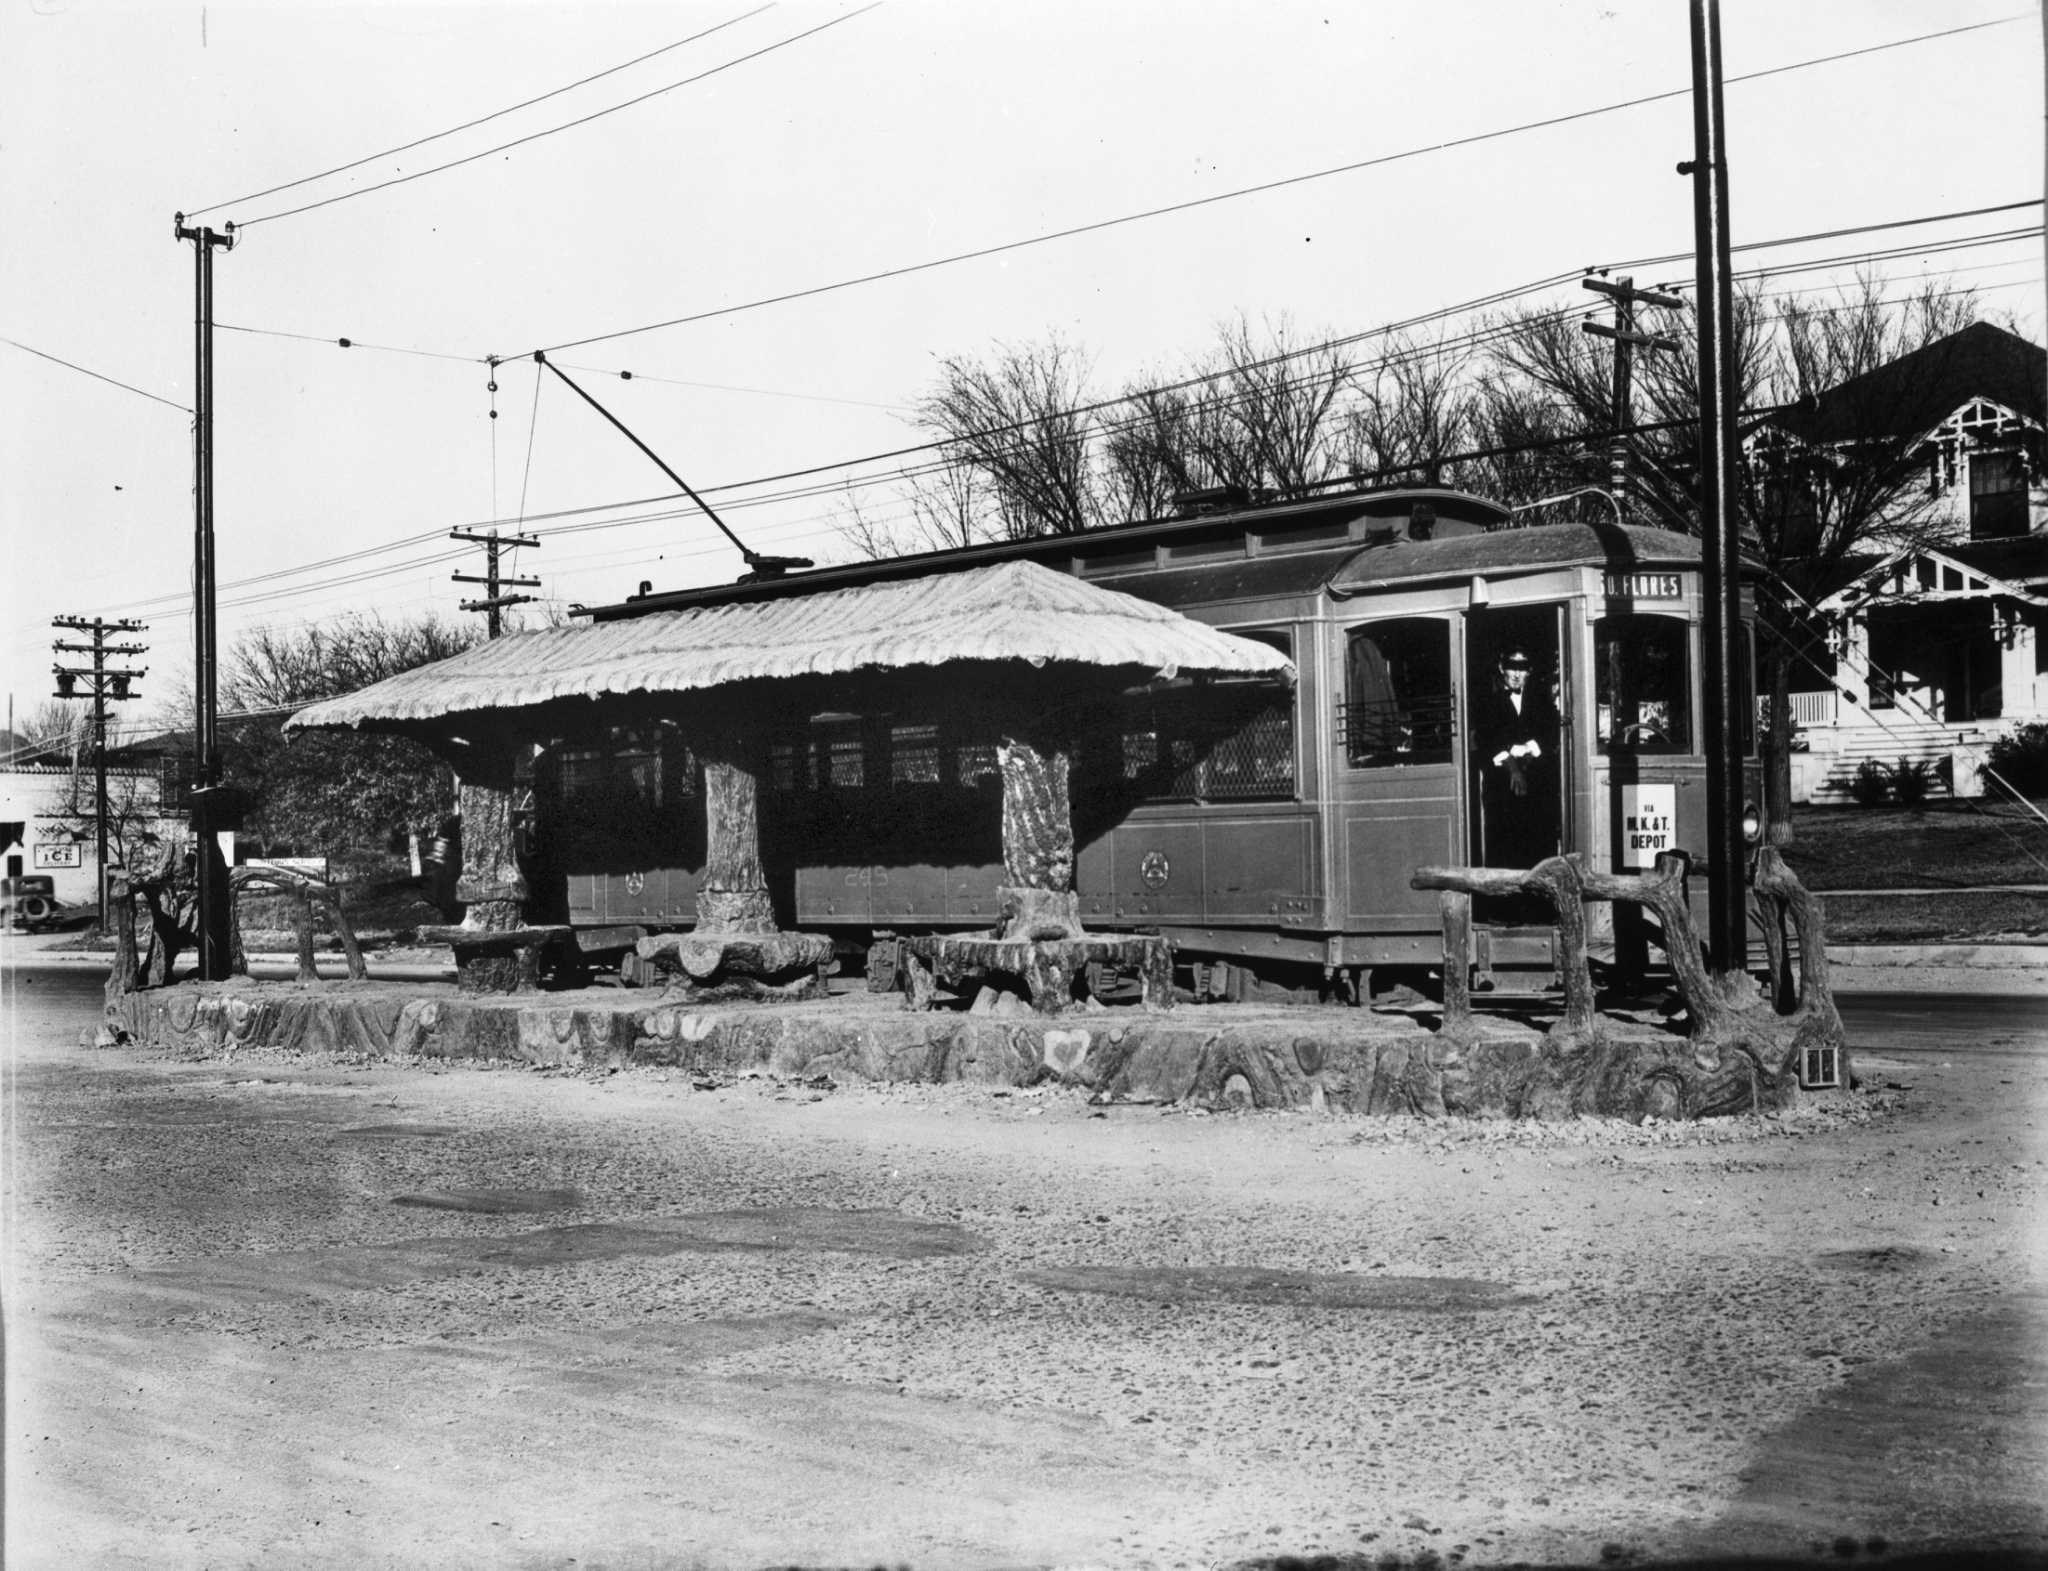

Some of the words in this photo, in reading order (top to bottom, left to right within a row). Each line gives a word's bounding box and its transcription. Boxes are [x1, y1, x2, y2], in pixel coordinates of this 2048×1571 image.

[1623, 575, 1679, 596] FLORES
[1644, 804, 1655, 813] VIA
[1631, 834, 1667, 849] DEPOT
[44, 850, 73, 861] ICE
